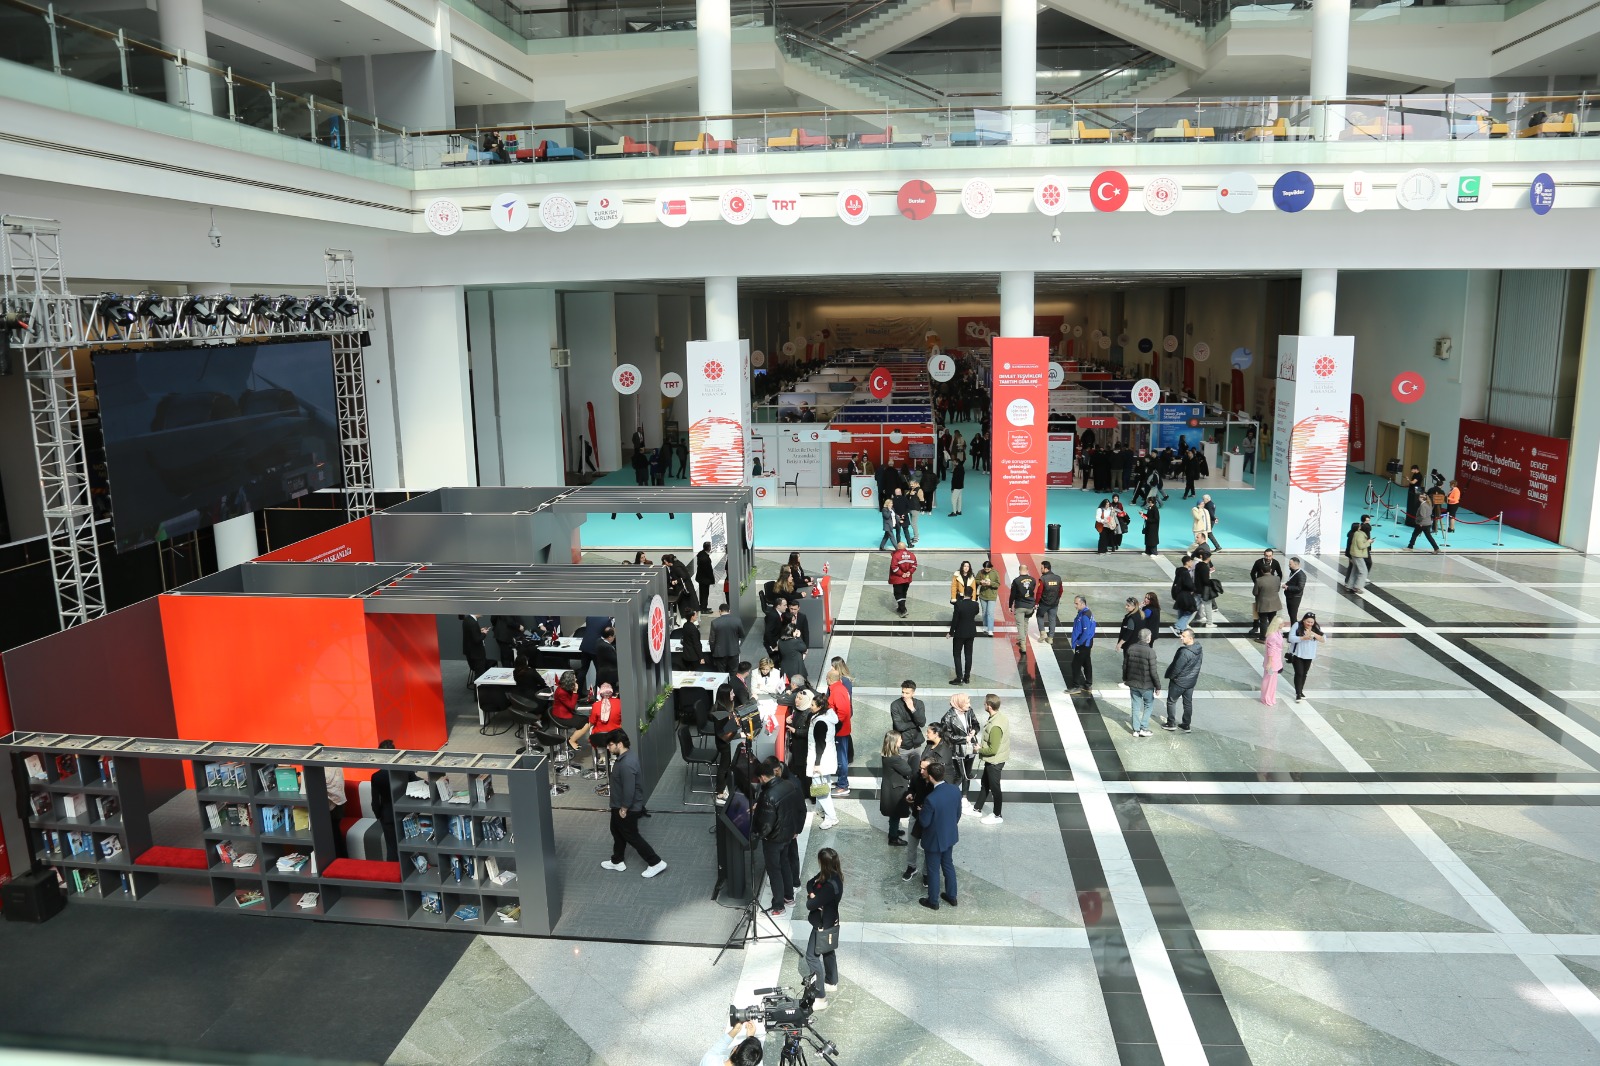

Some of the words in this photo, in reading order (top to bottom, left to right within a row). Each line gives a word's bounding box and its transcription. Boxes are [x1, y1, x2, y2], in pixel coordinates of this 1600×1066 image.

[771, 200, 797, 211] TRT
[663, 381, 680, 389] TRT
[1464, 435, 1484, 447] Gençler!
[1462, 446, 1470, 456] Bir
[1469, 448, 1494, 464] hayaliniz,
[1494, 454, 1522, 472] hedefiniz,
[1482, 463, 1489, 473] mi
[1489, 467, 1501, 477] var?
[1530, 461, 1548, 470] DEVLET
[1529, 470, 1557, 484] TEŞVİKLERİ
[1528, 480, 1549, 492] TANITIM
[1528, 489, 1548, 501] GÜNLERİ
